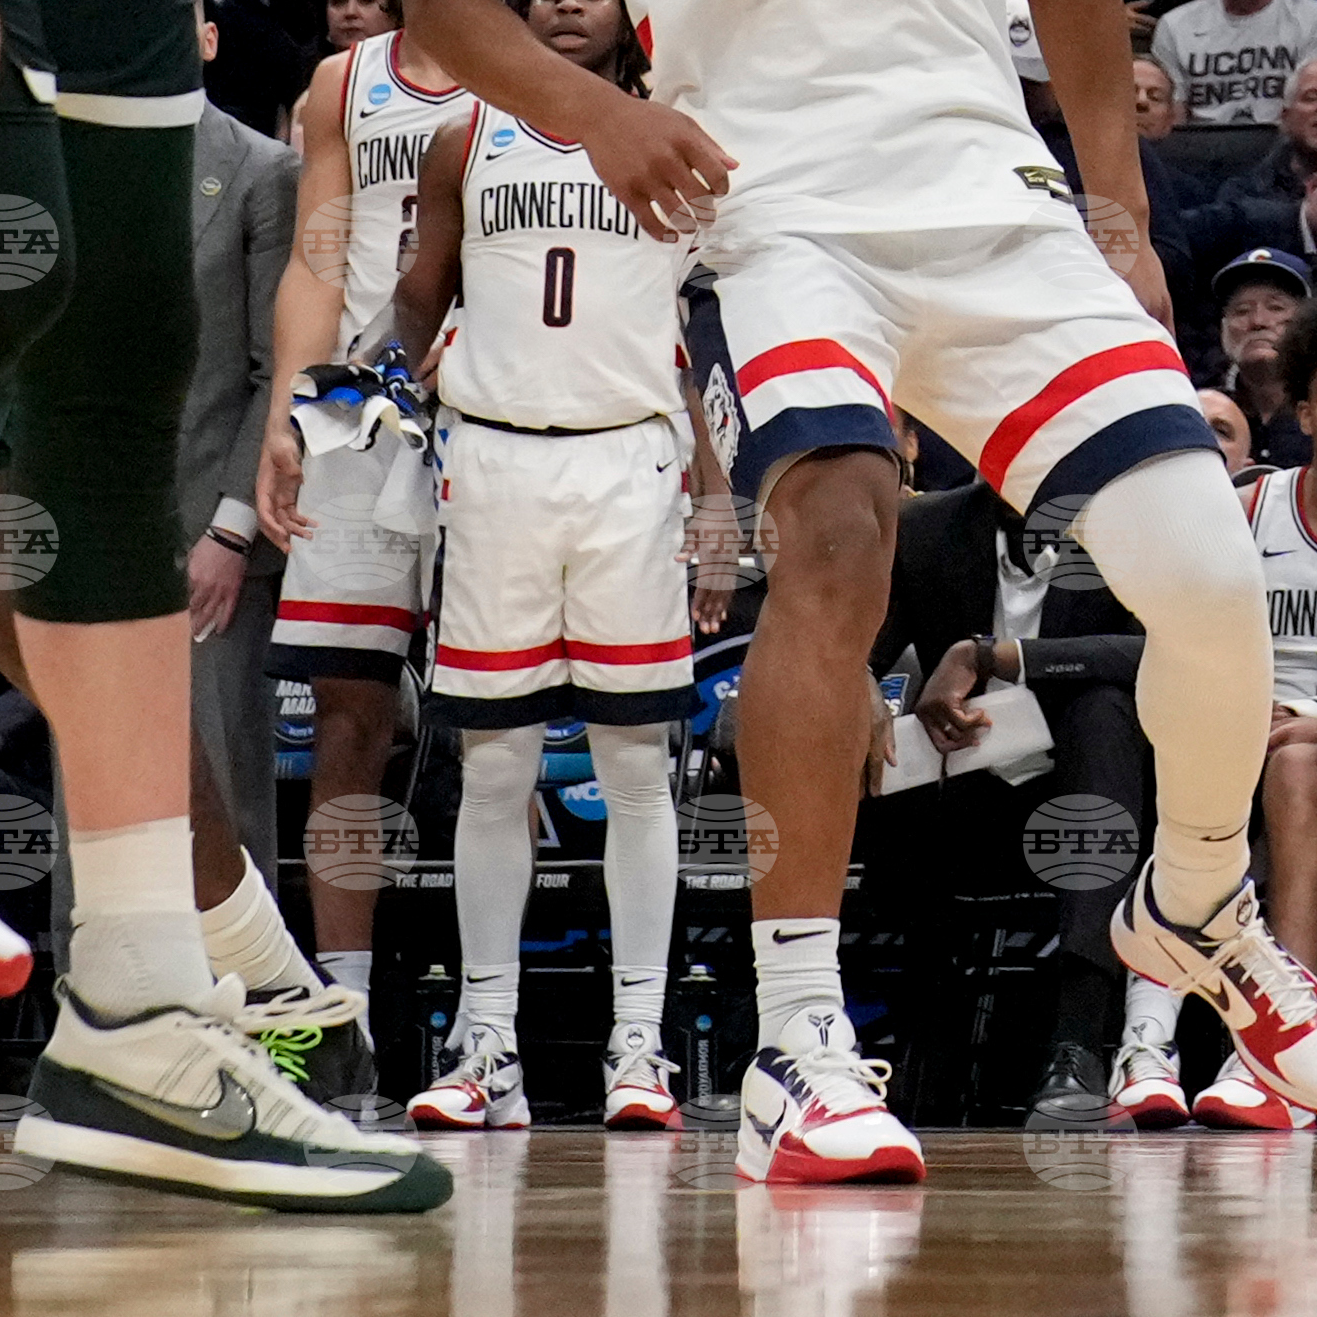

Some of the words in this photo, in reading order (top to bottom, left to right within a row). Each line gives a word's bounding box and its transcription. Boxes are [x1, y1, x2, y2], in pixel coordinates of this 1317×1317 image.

[1189, 45, 1297, 77] UCONN
[1188, 75, 1287, 106] ENERG
[542, 247, 577, 328] 0
[420, 873, 454, 888] ROAD
[535, 873, 570, 889] FOUR
[685, 874, 709, 890] THE
[709, 874, 747, 890] ROAD
